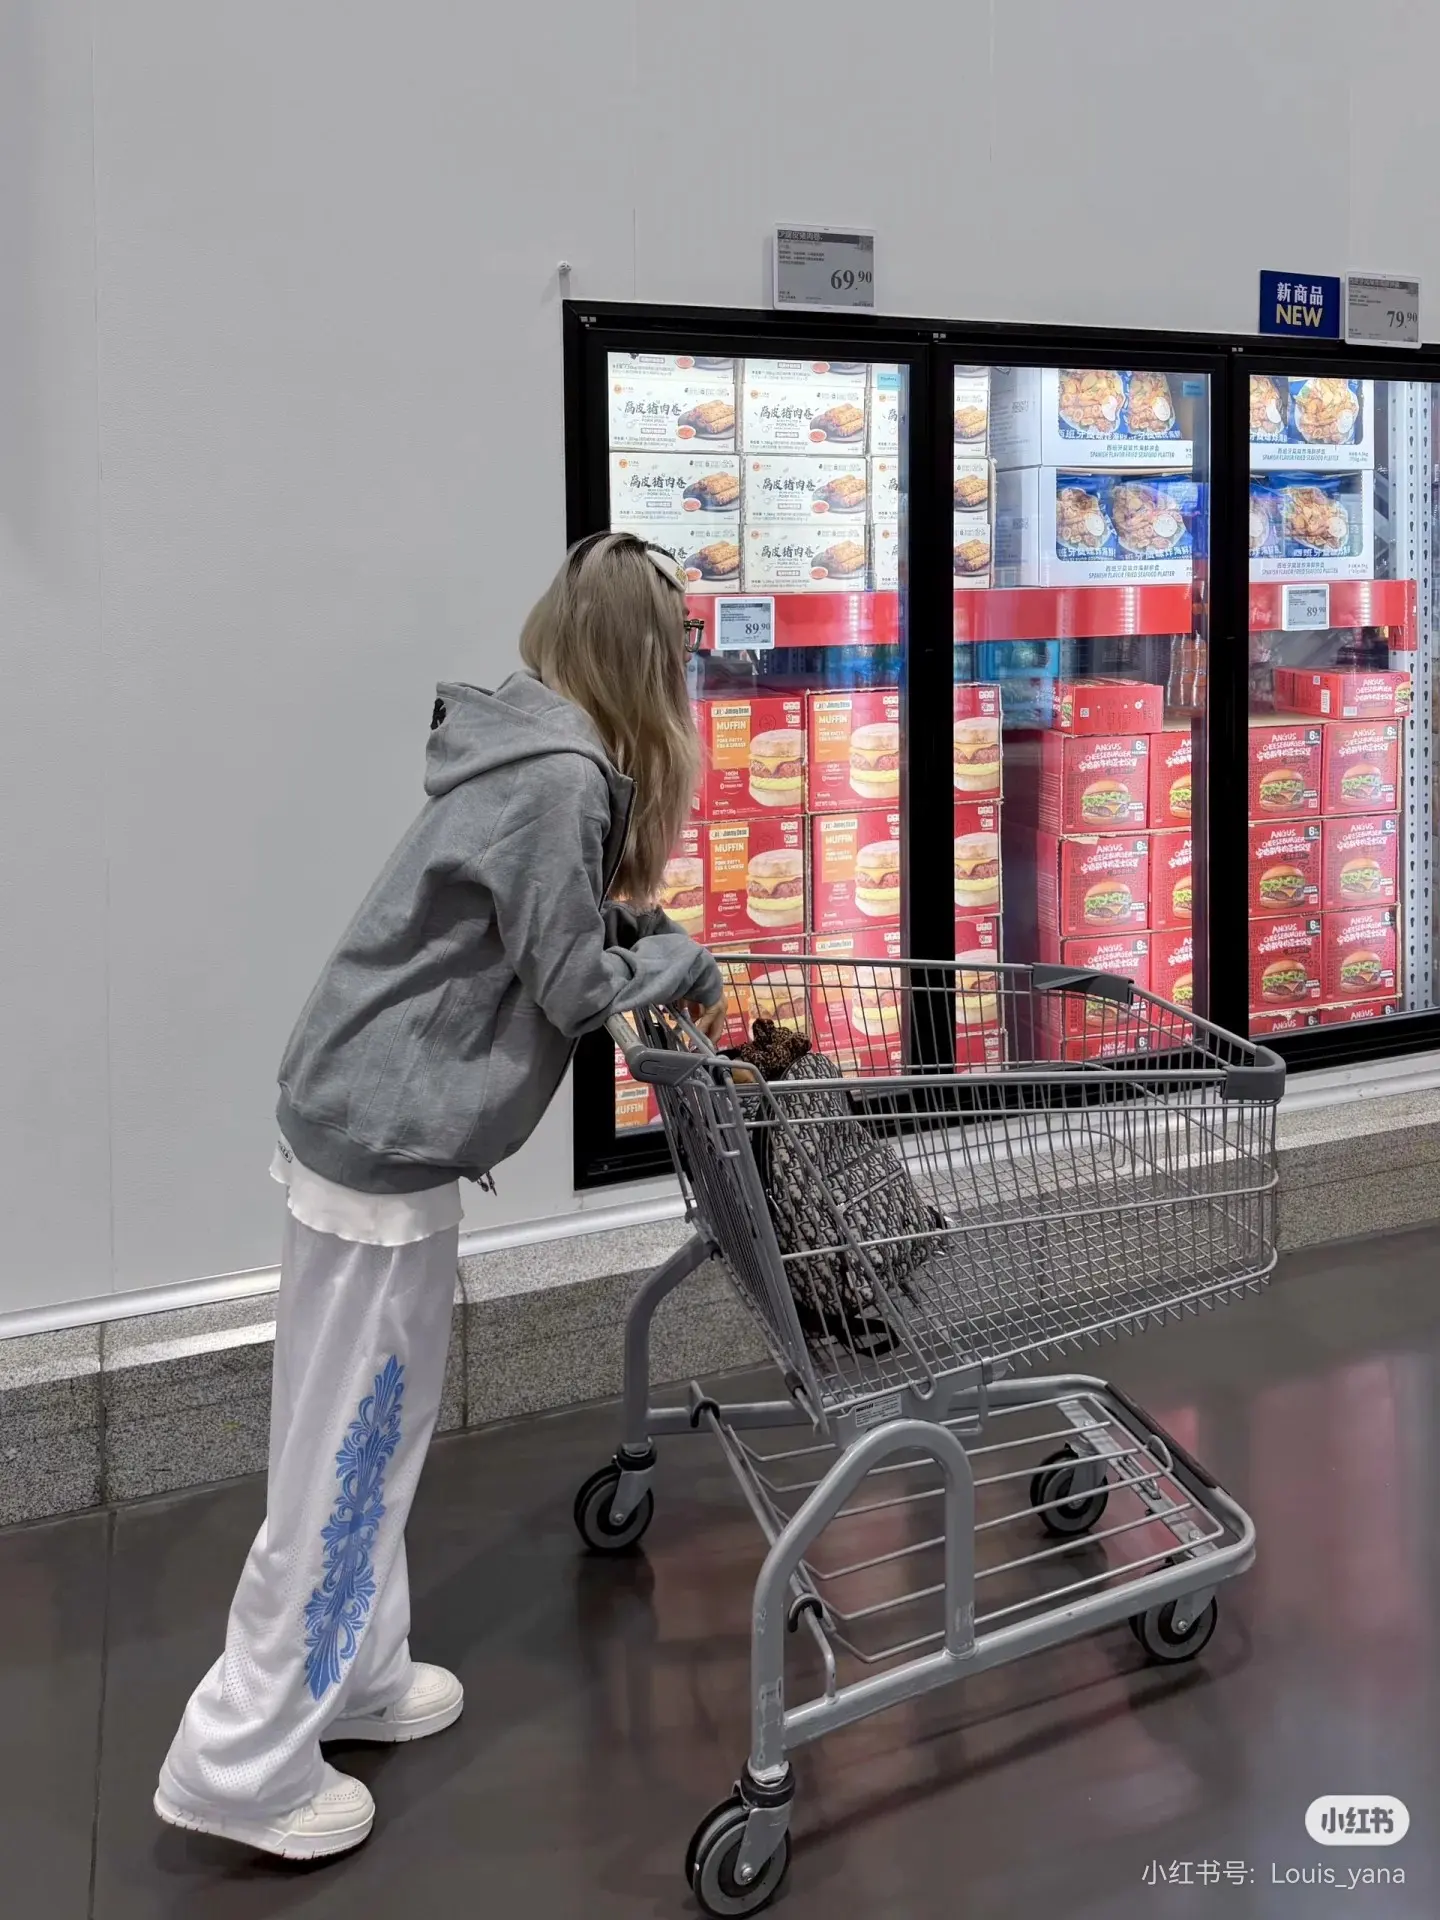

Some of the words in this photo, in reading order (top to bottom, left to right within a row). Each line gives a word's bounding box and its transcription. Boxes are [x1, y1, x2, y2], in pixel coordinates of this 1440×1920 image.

[1277, 282, 1323, 306] 新商品
[1276, 304, 1324, 327] NEW
[819, 714, 847, 724] MUFFIN
[717, 721, 746, 730] MUFFIN
[1387, 726, 1392, 735] 6
[1272, 733, 1297, 743] ANGUS
[1310, 731, 1315, 740] 6
[1352, 728, 1376, 738] ANGUS
[1095, 742, 1122, 752] ANGUS
[1136, 741, 1141, 750] 6
[1350, 823, 1374, 832] ANGUS
[1385, 820, 1391, 829] 6
[1271, 829, 1296, 839] ANGUS
[1309, 827, 1314, 836] 6
[826, 834, 853, 844] MUFFIN
[715, 843, 744, 853] MUFFIN
[1096, 844, 1123, 852] ANGUS
[1137, 841, 1143, 850] 6
[1350, 915, 1374, 925] ANGUS
[1385, 912, 1390, 921] 6
[1272, 923, 1297, 933] ANGUS
[1310, 920, 1315, 929] 6
[1097, 943, 1124, 953] ANGUS
[1350, 1009, 1374, 1020] ANGUS
[1385, 1006, 1391, 1014] 6
[1272, 1020, 1296, 1031] ANGUS
[1308, 1016, 1314, 1025] 6
